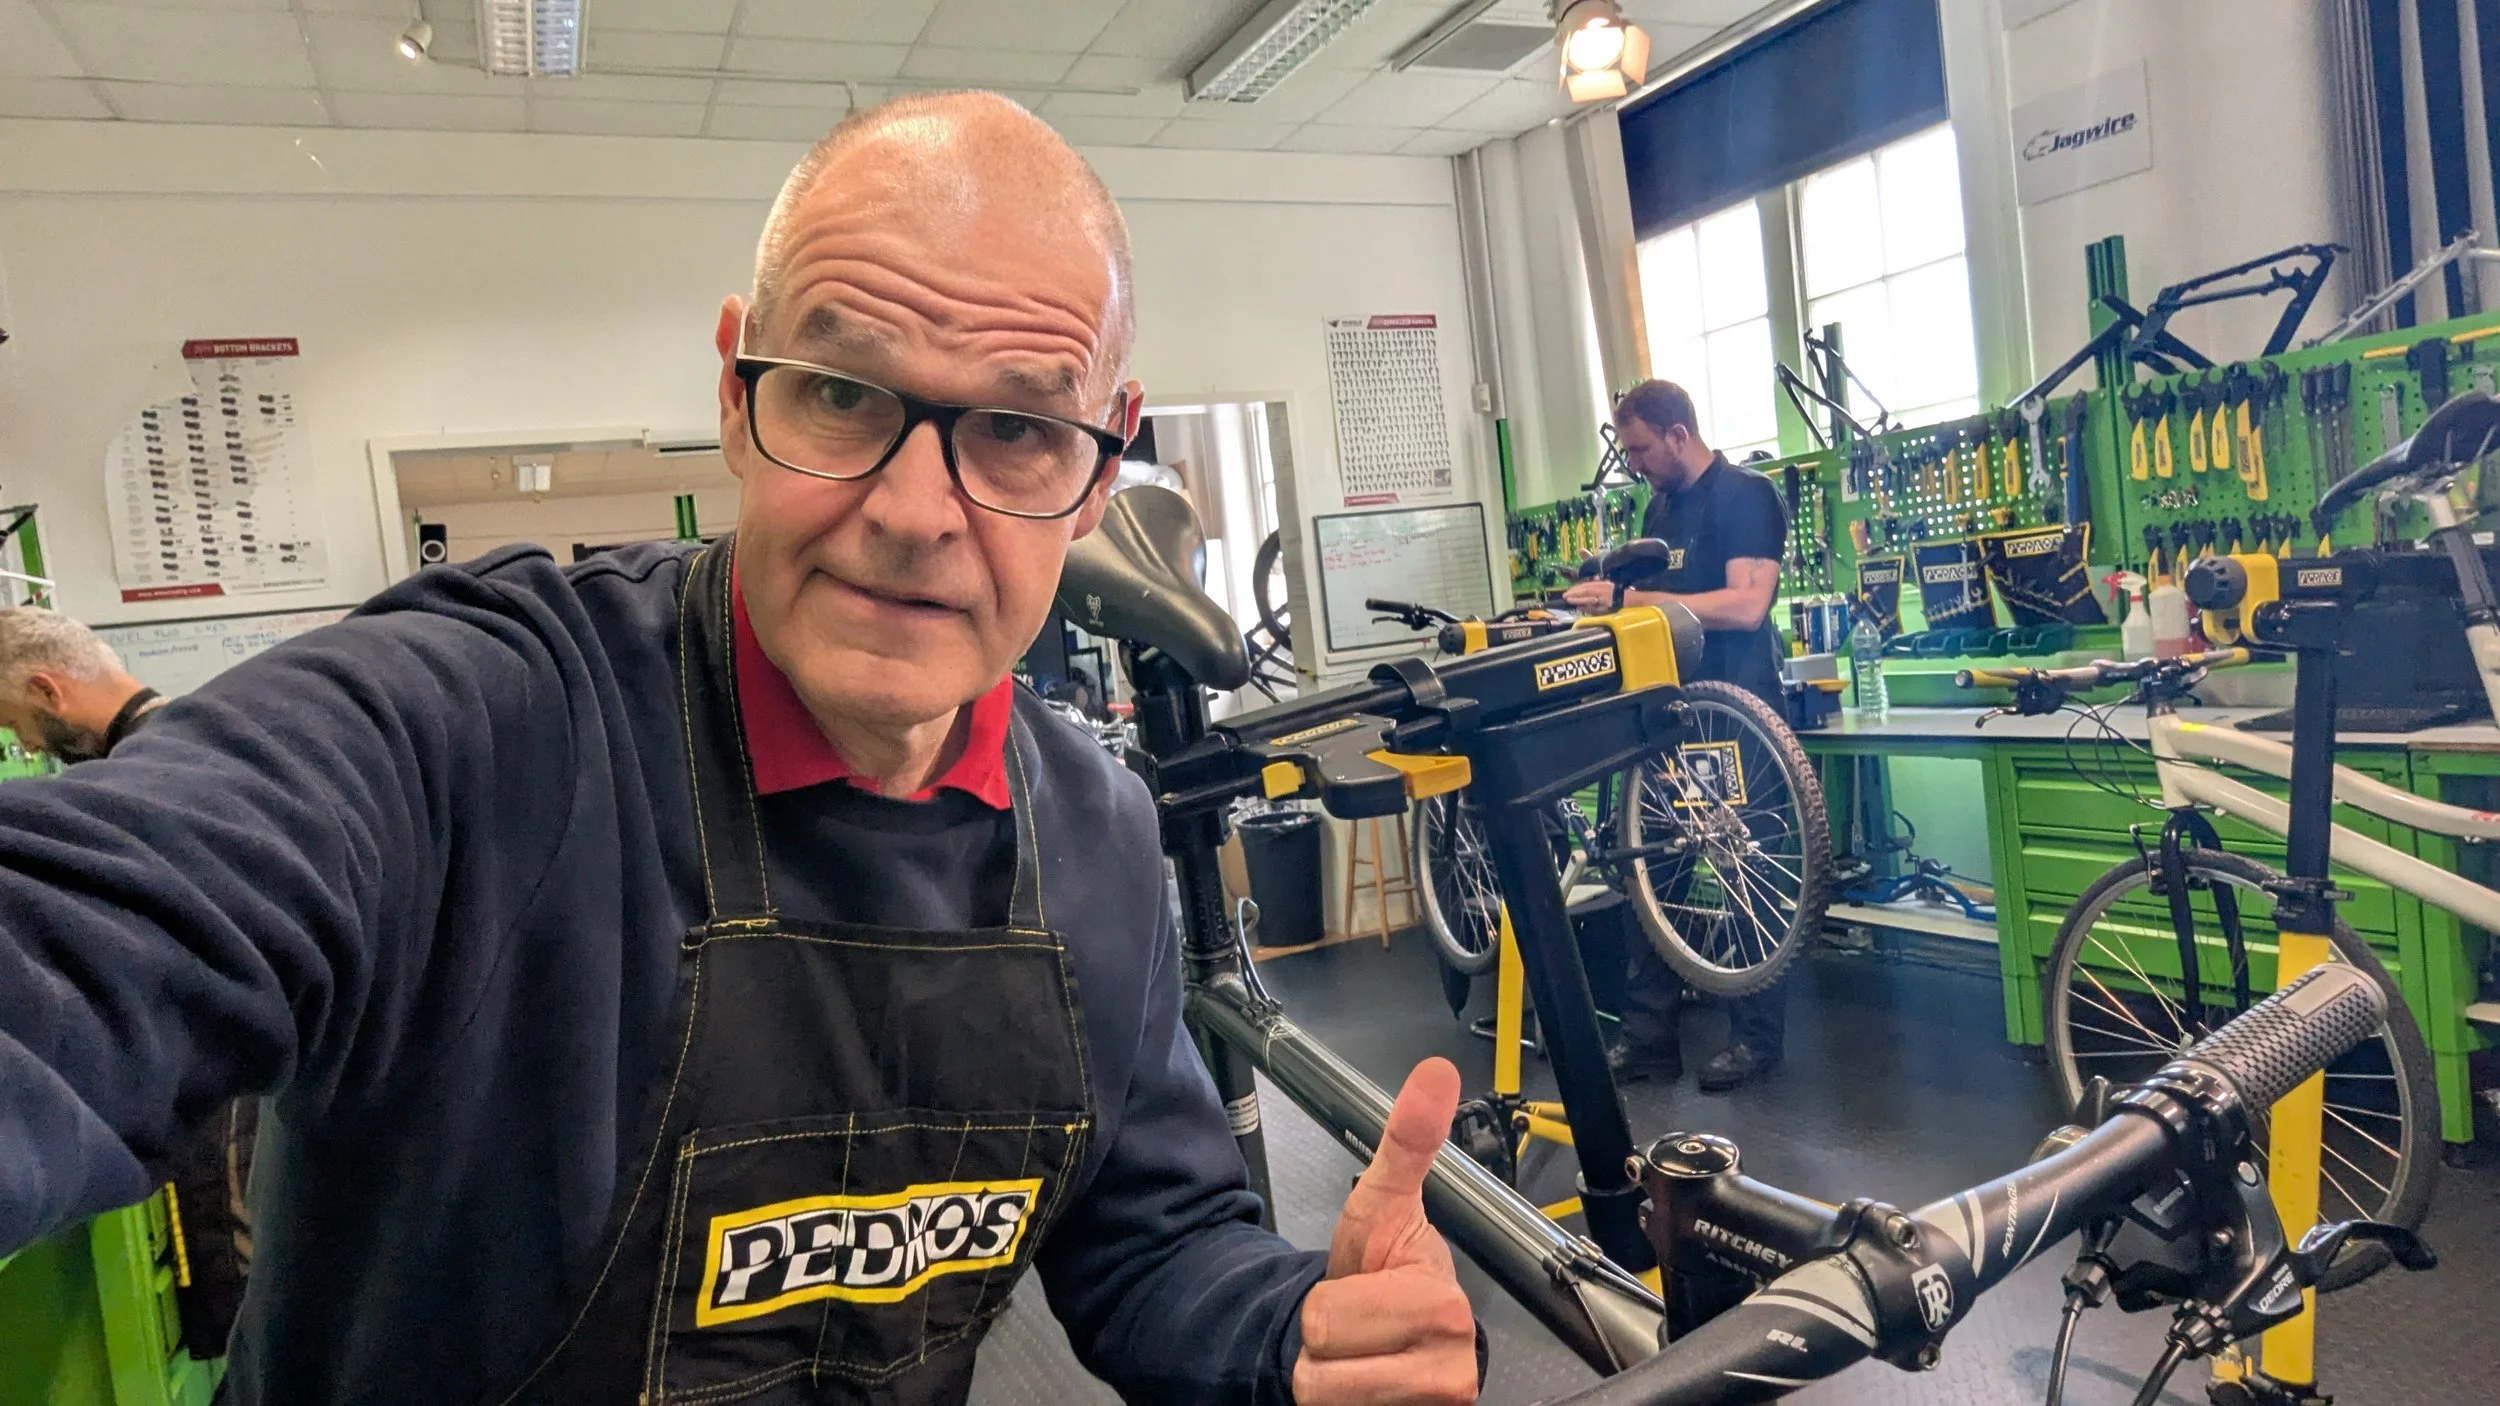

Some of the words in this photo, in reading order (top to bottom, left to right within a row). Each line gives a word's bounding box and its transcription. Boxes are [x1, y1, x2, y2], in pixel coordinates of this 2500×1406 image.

[2048, 113, 2137, 153] Jagwire
[2002, 1179, 2018, 1259] BONTRAGE
[1694, 1219, 1793, 1269] RITCHEY
[2259, 1271, 2295, 1311] DEORE
